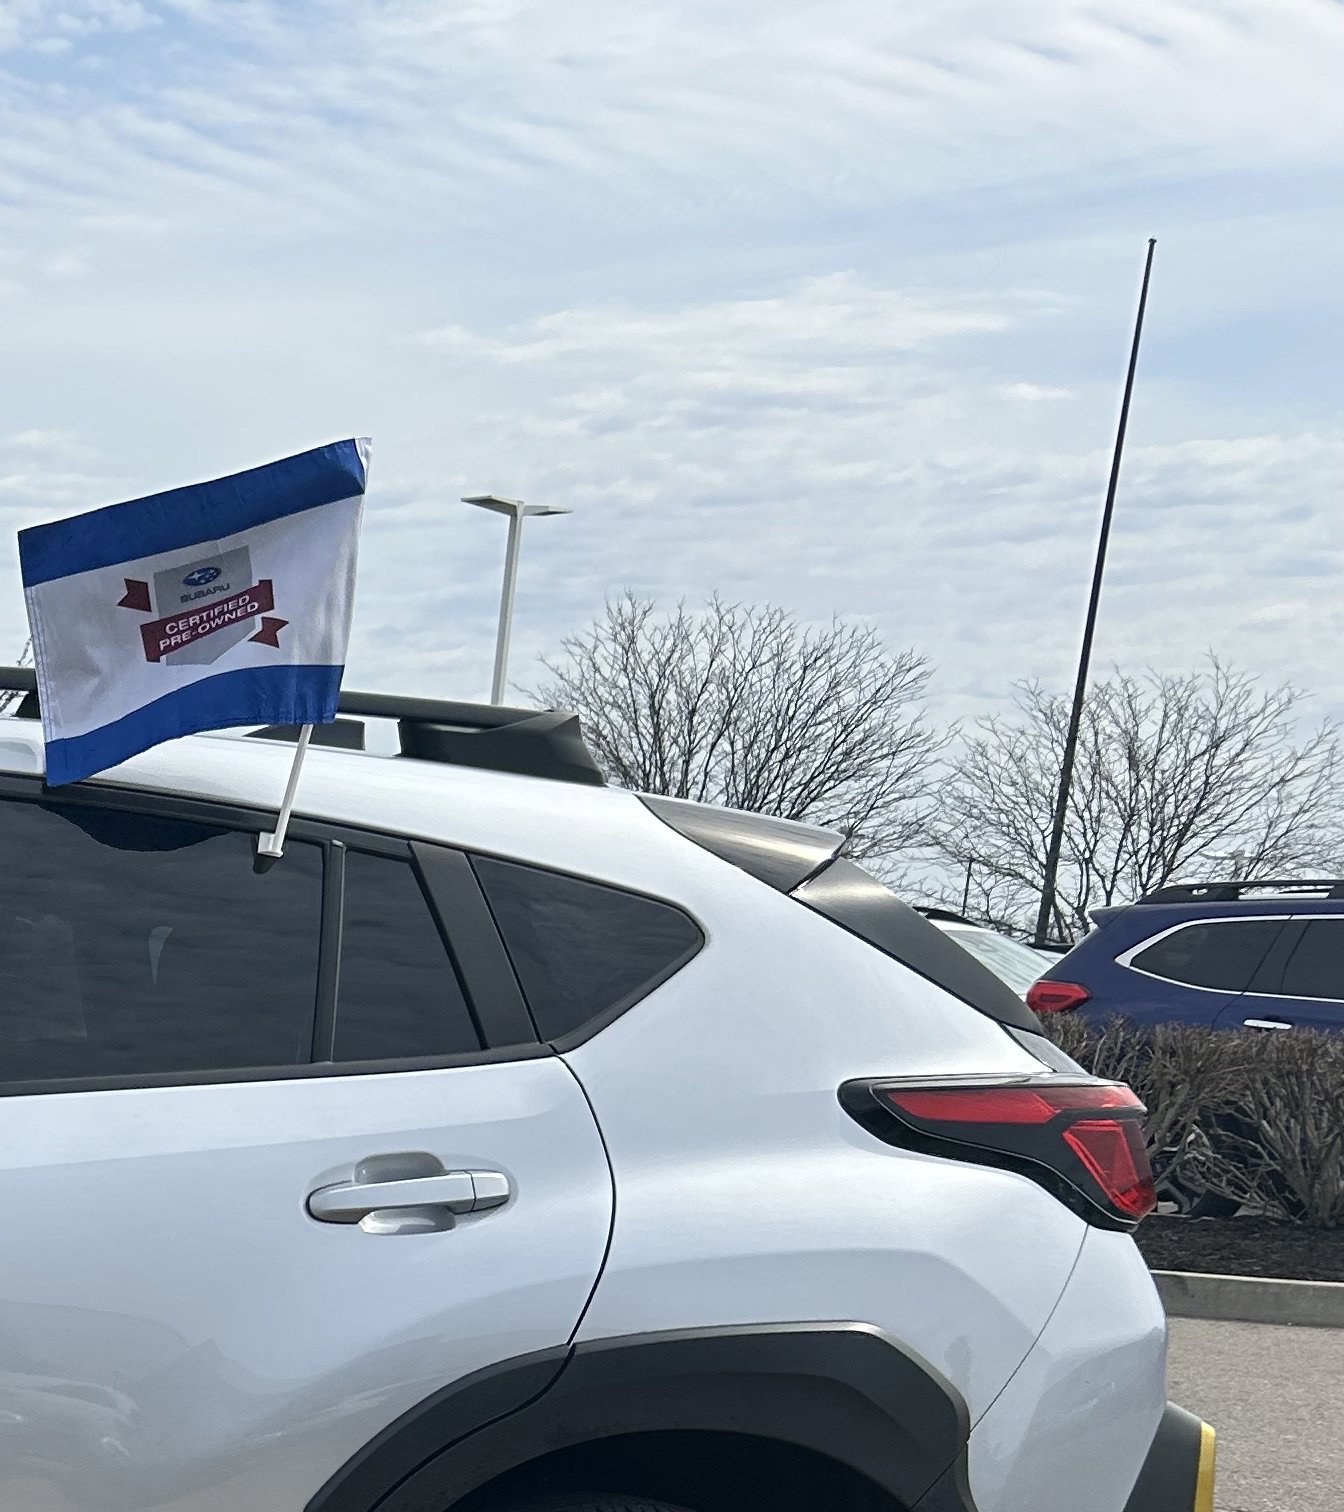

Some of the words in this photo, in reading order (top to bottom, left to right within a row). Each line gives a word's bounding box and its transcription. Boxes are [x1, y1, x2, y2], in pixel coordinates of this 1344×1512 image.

[180, 583, 230, 603] SUBARU
[159, 602, 259, 651] PRE-OWNED
[165, 595, 250, 634] CERTIFIED
